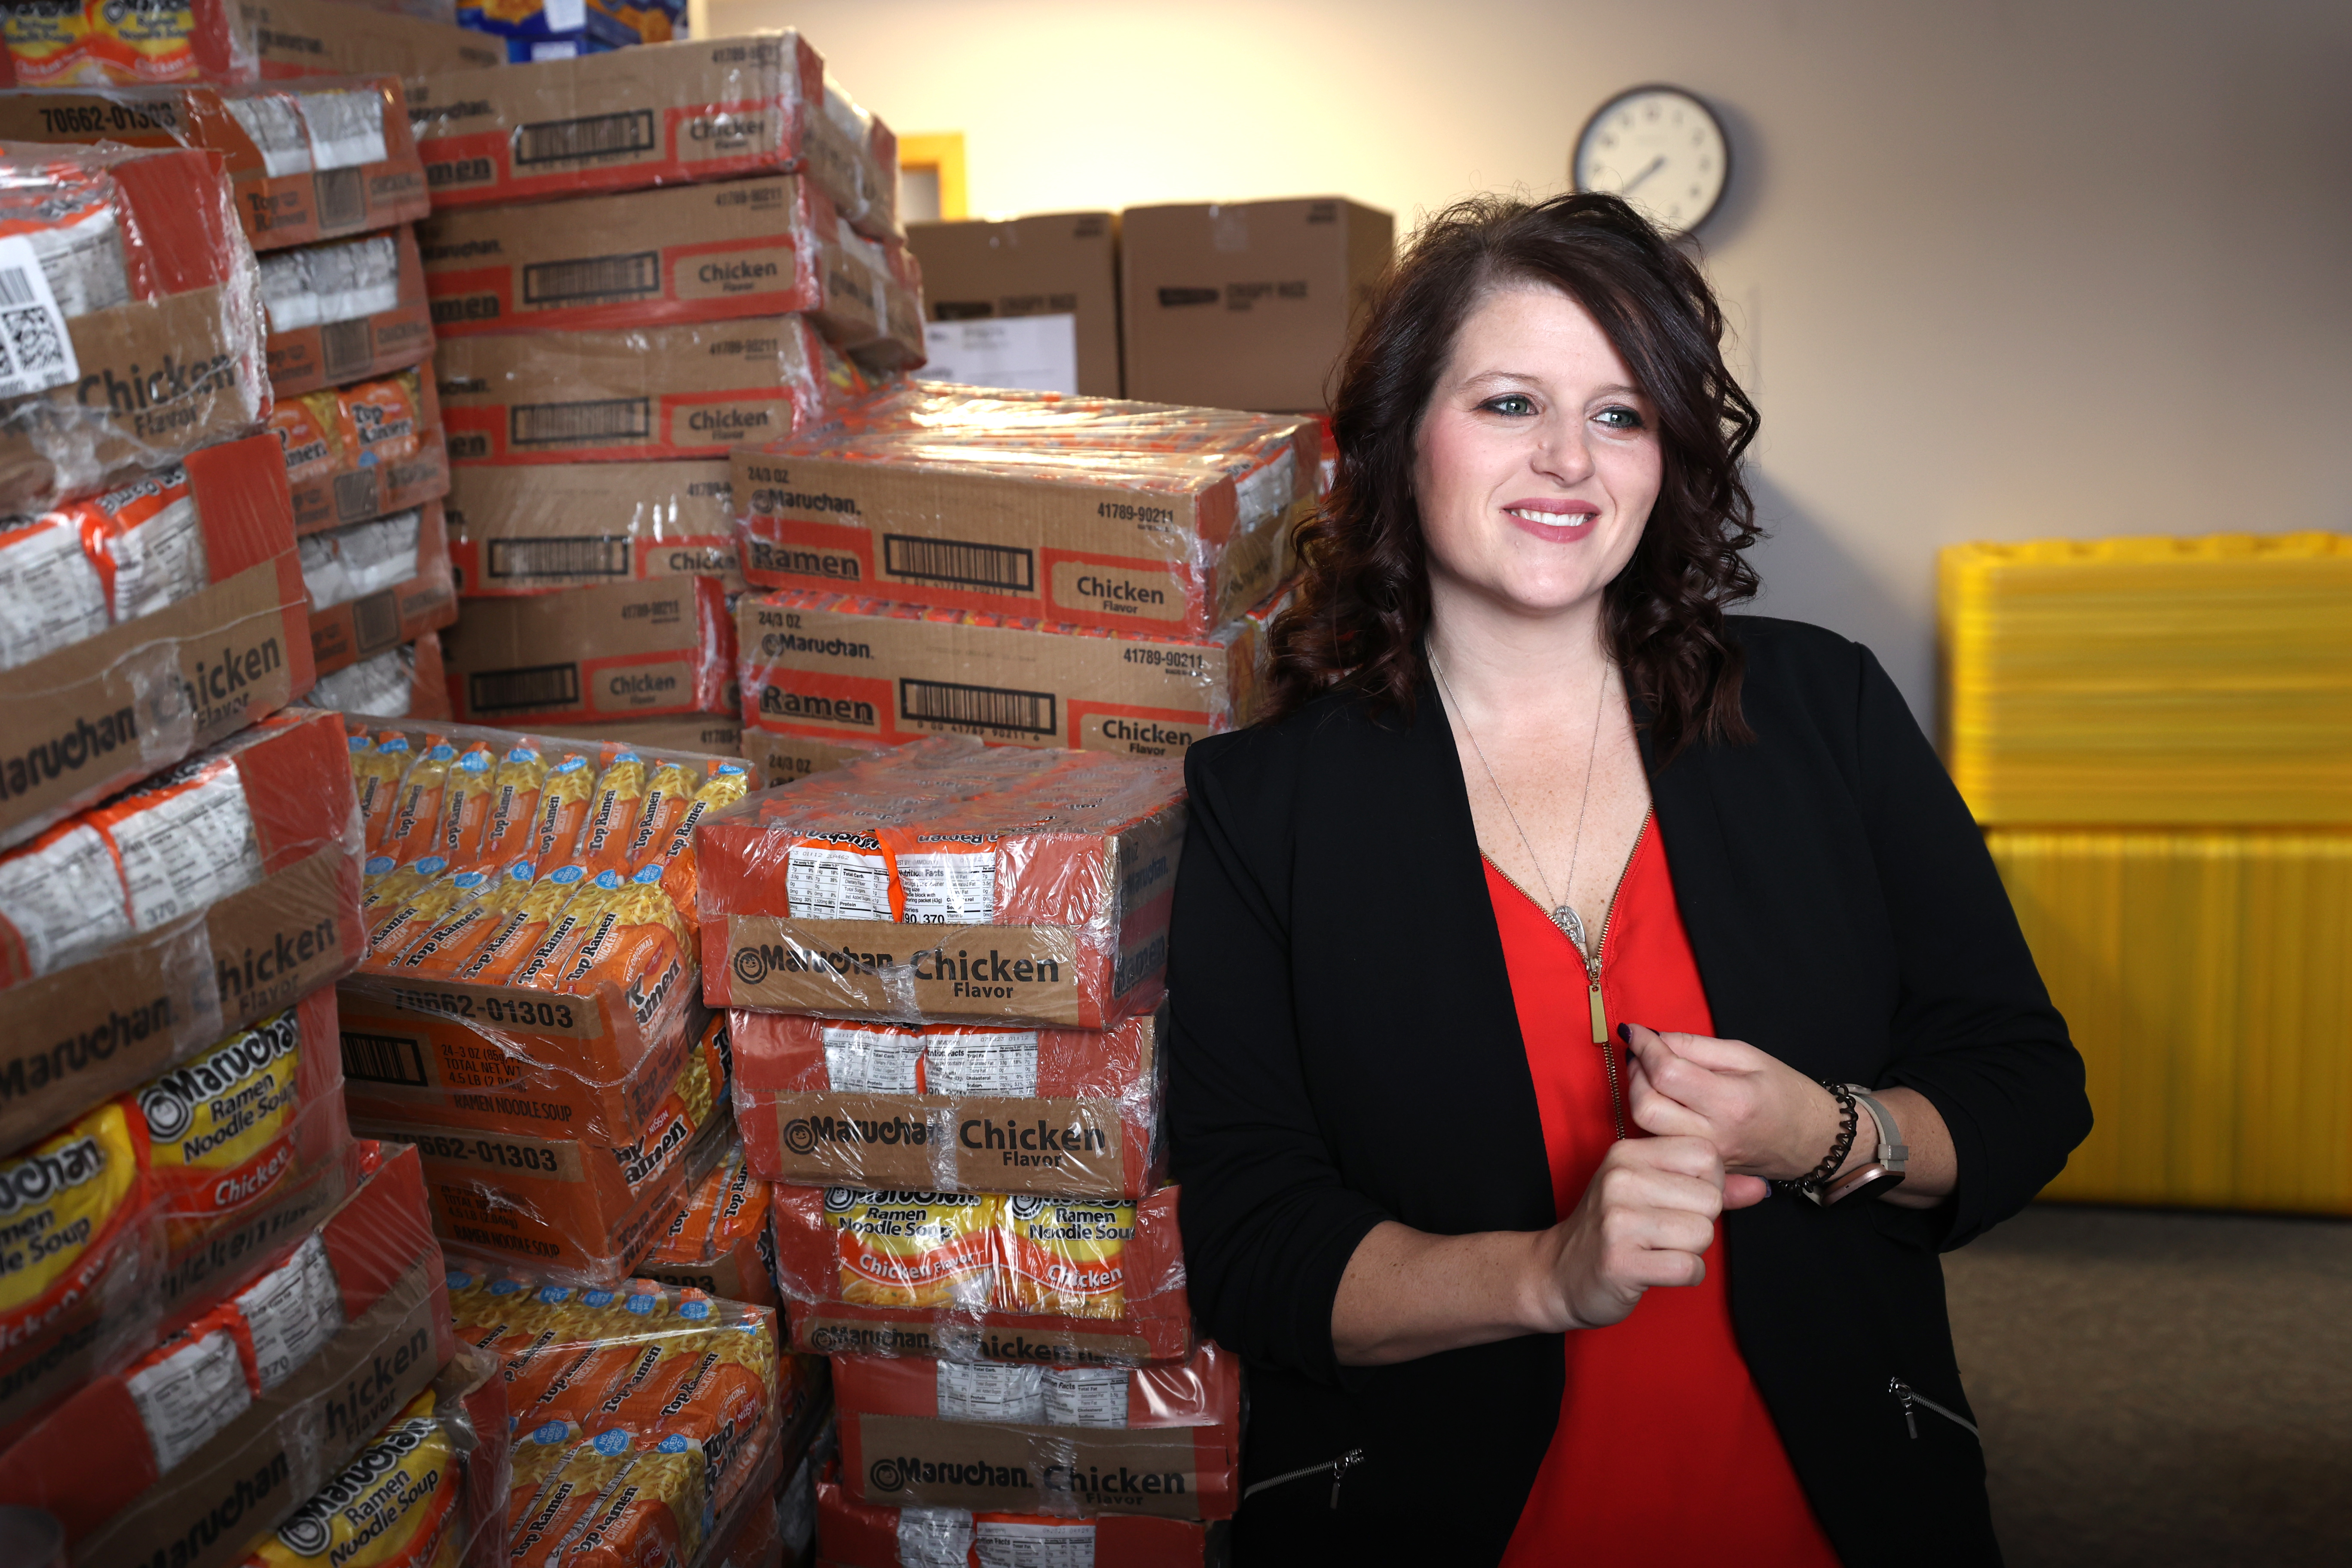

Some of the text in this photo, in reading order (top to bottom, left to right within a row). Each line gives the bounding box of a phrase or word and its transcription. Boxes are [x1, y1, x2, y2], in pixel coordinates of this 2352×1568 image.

[426, 157, 491, 187] men
[698, 260, 777, 283] Chicken
[430, 295, 500, 325] men
[77, 353, 236, 418] Chicken
[689, 408, 769, 431] Chicken
[1097, 502, 1174, 524] 41789-90211
[751, 542, 860, 581] Ramen
[1077, 576, 1164, 605] Chicken
[786, 614, 801, 629] OZ
[1103, 601, 1138, 615] Flavor
[780, 633, 874, 659] Maruchan.
[1124, 648, 1203, 669] 41789-90211
[609, 673, 676, 696] Chicken
[759, 685, 874, 726] Ramen
[1102, 720, 1193, 746] Chicken
[0, 706, 137, 800] aruchan
[1130, 743, 1166, 756] Flavor
[796, 759, 812, 774] OZ
[489, 785, 514, 840] Top Ramen
[540, 795, 560, 835] Ramen
[588, 789, 617, 850] Top Ramen
[632, 790, 662, 849] Top Ramen
[395, 818, 416, 839] Top
[666, 800, 707, 857] Top Ramen
[561, 866, 572, 882] ADDED
[925, 869, 944, 877] Facts
[371, 907, 419, 946] Ramen
[923, 914, 945, 924] 370
[405, 907, 486, 967] Top Ramen
[439, 924, 475, 949] CHICKEN
[461, 910, 529, 980] Top Ramen
[495, 930, 525, 958] CHICKEN
[517, 914, 578, 985] Top Ramen
[565, 911, 617, 981] Top Ramen
[594, 932, 619, 964] CHICKEN
[626, 937, 654, 983] THE ORIGINAL
[916, 949, 1059, 983] Chicken
[238, 974, 300, 1017] Flavor
[634, 952, 682, 1025] amen
[954, 982, 1014, 999] Flavor
[441, 1044, 481, 1060] 24-3 OZ
[444, 1058, 500, 1075] TOTAL NET
[449, 1072, 481, 1086] 4.5 LB
[210, 1073, 275, 1122] Ramen
[454, 1094, 573, 1122] RAMEN NOODLE SOUP
[648, 1109, 670, 1135] NISSIN
[959, 1119, 1106, 1152] Chicken
[183, 1110, 254, 1164] Noodle
[625, 1117, 688, 1185] amen
[1002, 1150, 1062, 1168] Flavor
[214, 1143, 290, 1207] Chicken
[442, 1194, 473, 1208] TOTAL
[724, 1193, 746, 1218] Top
[867, 1206, 928, 1222] Ramen
[0, 1206, 55, 1243] men
[480, 1211, 519, 1230] (2.04kg)
[668, 1205, 691, 1237] Top
[839, 1217, 952, 1242] Noodle Soup
[1055, 1207, 1116, 1224] Ramen
[28, 1217, 91, 1265] Soup
[453, 1225, 560, 1259] RAMEN NOODLE SOUP
[1029, 1222, 1092, 1240] Noodle
[859, 1250, 975, 1280] Chicken Flavor
[1047, 1263, 1123, 1290] Chicken
[323, 1323, 429, 1441] hicken
[570, 1357, 600, 1385] CHICKEN
[1058, 1380, 1076, 1390] Facts
[536, 1378, 569, 1404] Top
[601, 1387, 631, 1413] Top
[691, 1371, 718, 1401] CHICKEN
[344, 1391, 398, 1446] Flavor
[660, 1393, 691, 1417] Top
[737, 1397, 757, 1423] NISSIN
[539, 1428, 548, 1439] NO
[545, 1423, 557, 1442] ADDED
[598, 1433, 607, 1445] NO
[604, 1430, 619, 1452] ADDED
[612, 1434, 624, 1450] MSG
[307, 1415, 435, 1522] Maruchan
[895, 1457, 1035, 1489] Maruchan.
[1042, 1464, 1186, 1495] Chicken
[344, 1468, 412, 1528] Ramen
[394, 1467, 440, 1516] Soup
[1085, 1491, 1144, 1507] Flavor
[511, 1481, 574, 1558] Top Ramen
[543, 1504, 573, 1535] CHICKEN
[604, 1507, 638, 1542] CHICKEN
